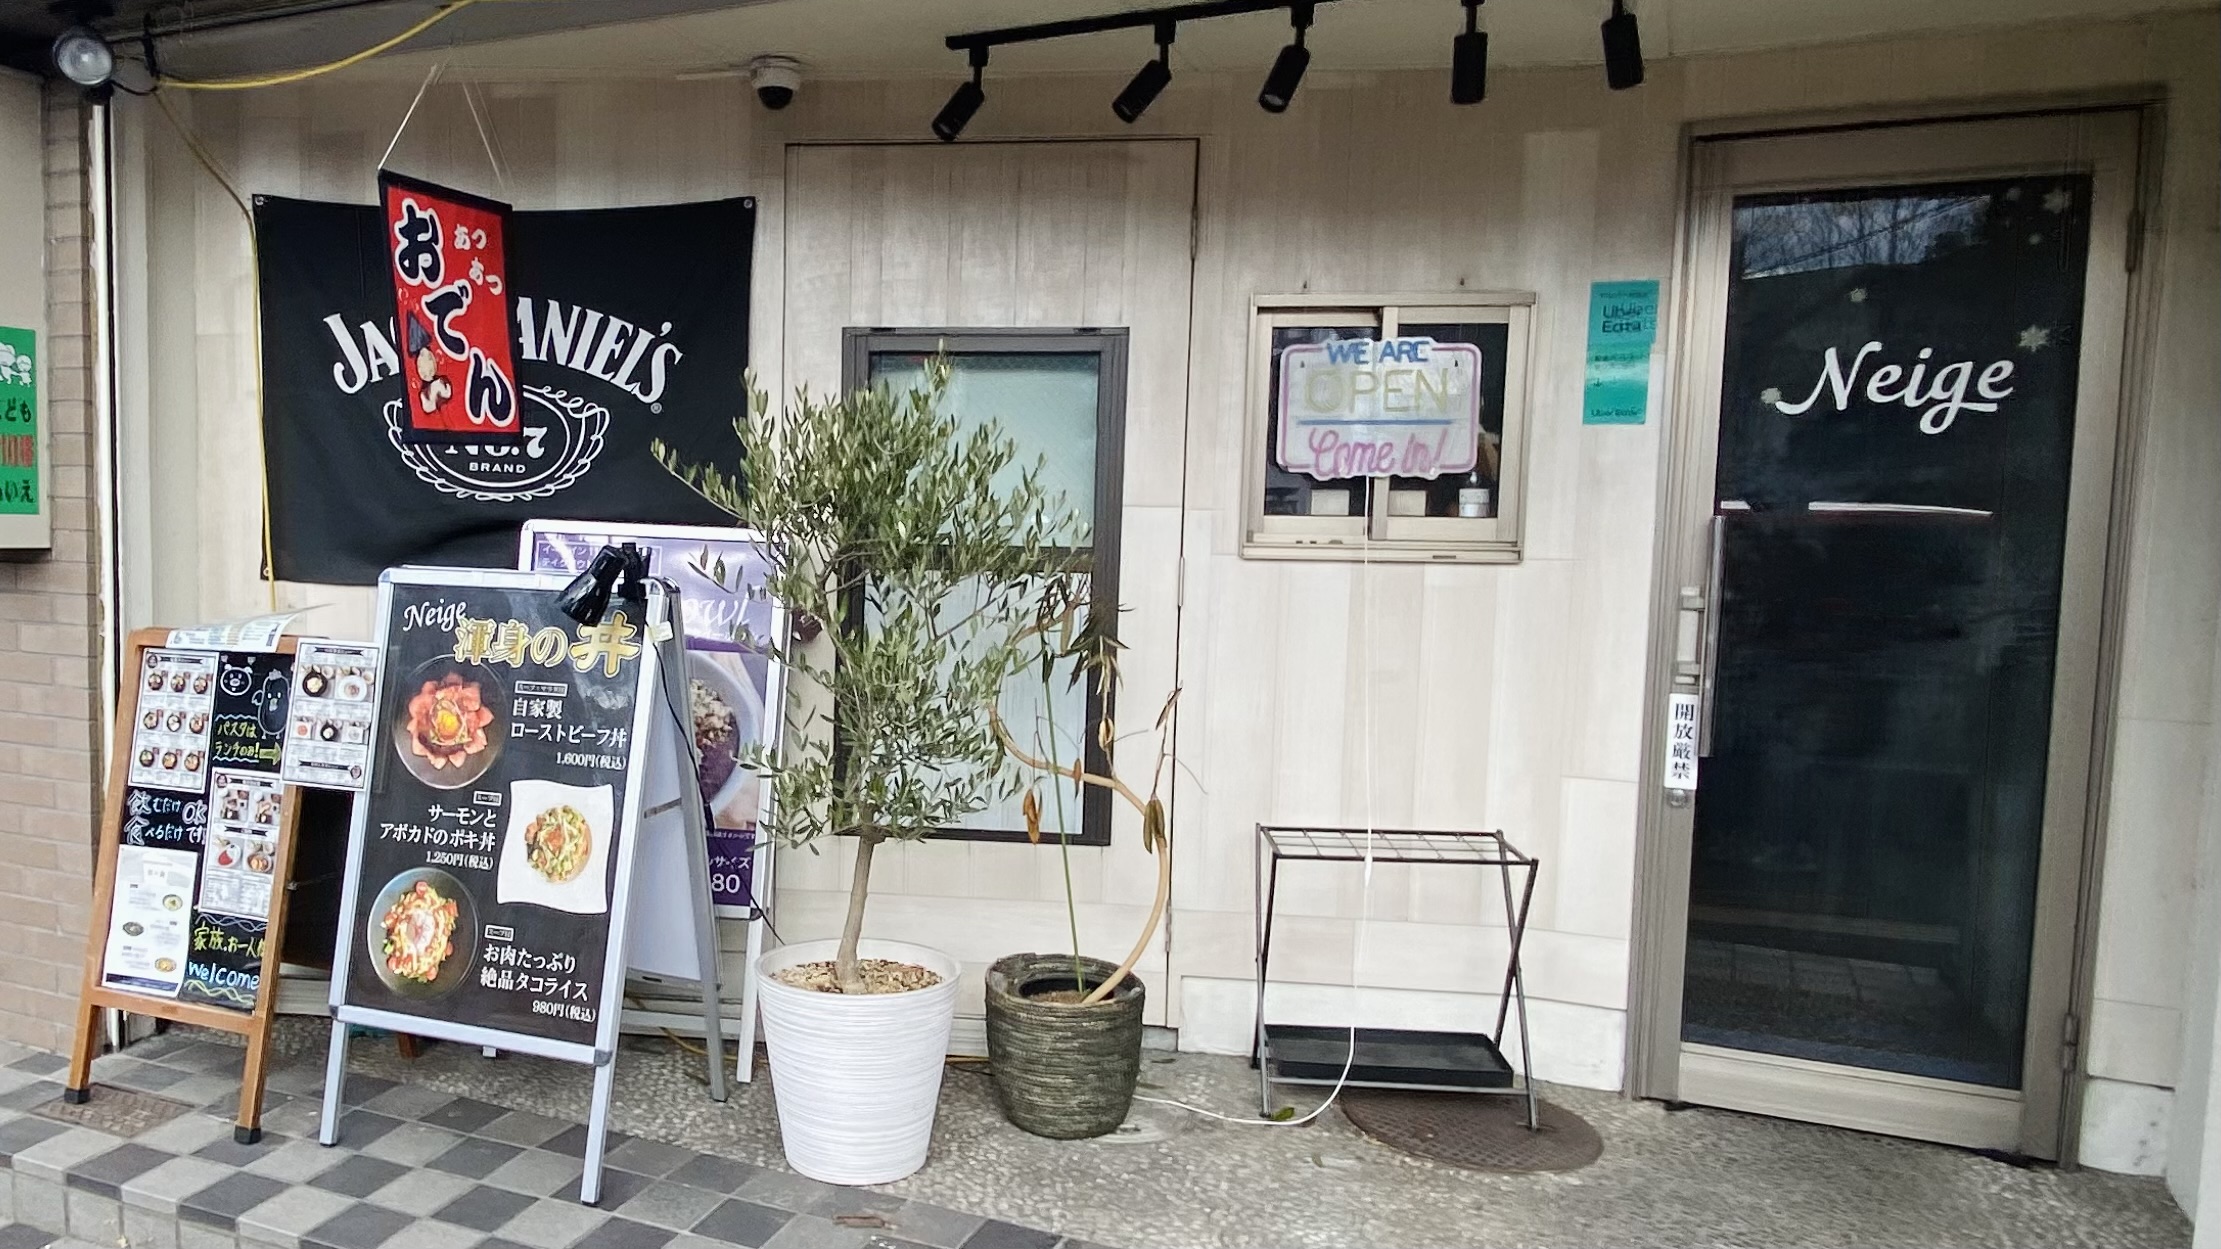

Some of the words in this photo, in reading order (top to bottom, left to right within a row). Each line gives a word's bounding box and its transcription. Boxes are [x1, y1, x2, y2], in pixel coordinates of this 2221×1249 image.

[395, 198, 516, 428] おでん
[322, 312, 401, 395] JA
[515, 296, 684, 404] ANIEL'S
[1327, 342, 1370, 365] WE
[1305, 367, 1449, 414] OPEN
[1775, 341, 2015, 435] Neige
[0, 397, 32, 423] ども
[469, 461, 527, 474] BRAND
[1308, 428, 1396, 477] Come
[0, 479, 33, 503] いえ
[402, 598, 467, 632] Neige
[512, 698, 563, 720] 自家製
[510, 722, 628, 749] ローストビーフ丼
[1672, 703, 1695, 780] 開放厳禁
[182, 799, 209, 826] OK
[428, 804, 497, 828] サーモンと
[124, 815, 184, 846] 食べるだけ
[379, 822, 496, 852] アボカドのポキ丼
[709, 856, 752, 871] サイズ
[483, 943, 576, 974] お肉たっぷり
[480, 966, 588, 1001] 絶品タコライス
[532, 1000, 596, 1023] 980円(税込)
